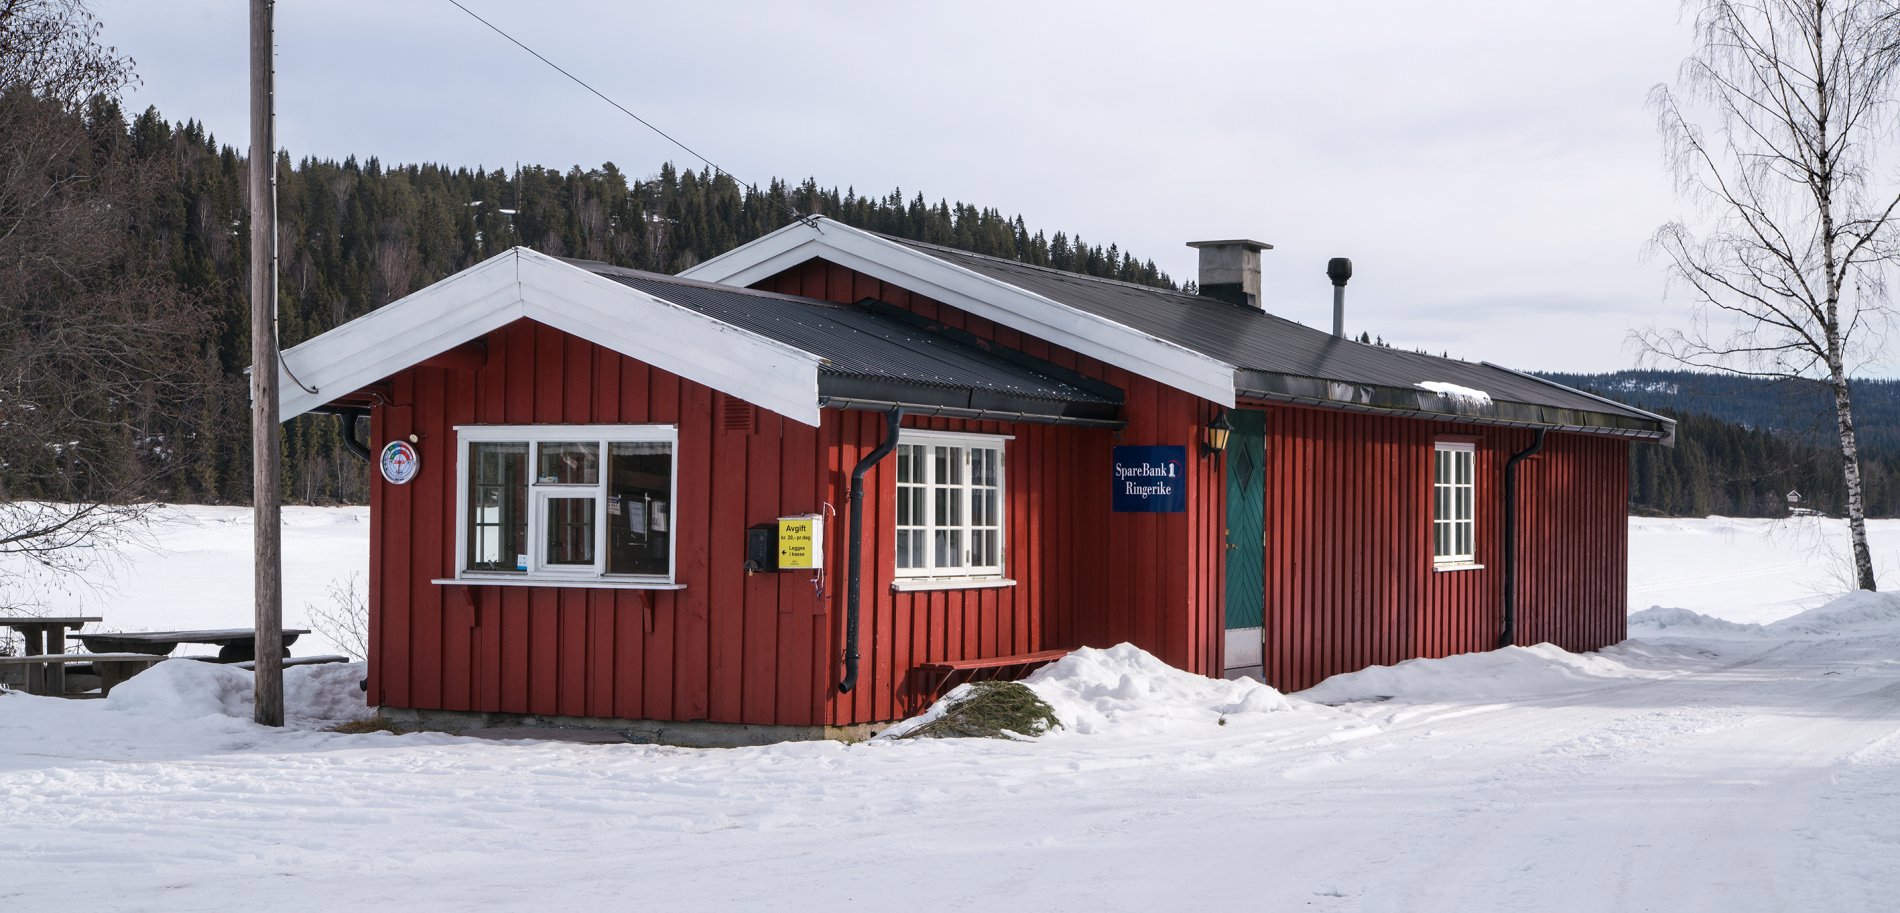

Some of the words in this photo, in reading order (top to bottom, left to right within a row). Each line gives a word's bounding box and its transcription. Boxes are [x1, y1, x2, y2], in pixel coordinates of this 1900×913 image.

[1116, 462, 1167, 480] SpareBank
[1126, 481, 1172, 499] Ringerike
[786, 525, 806, 533] Avgift
